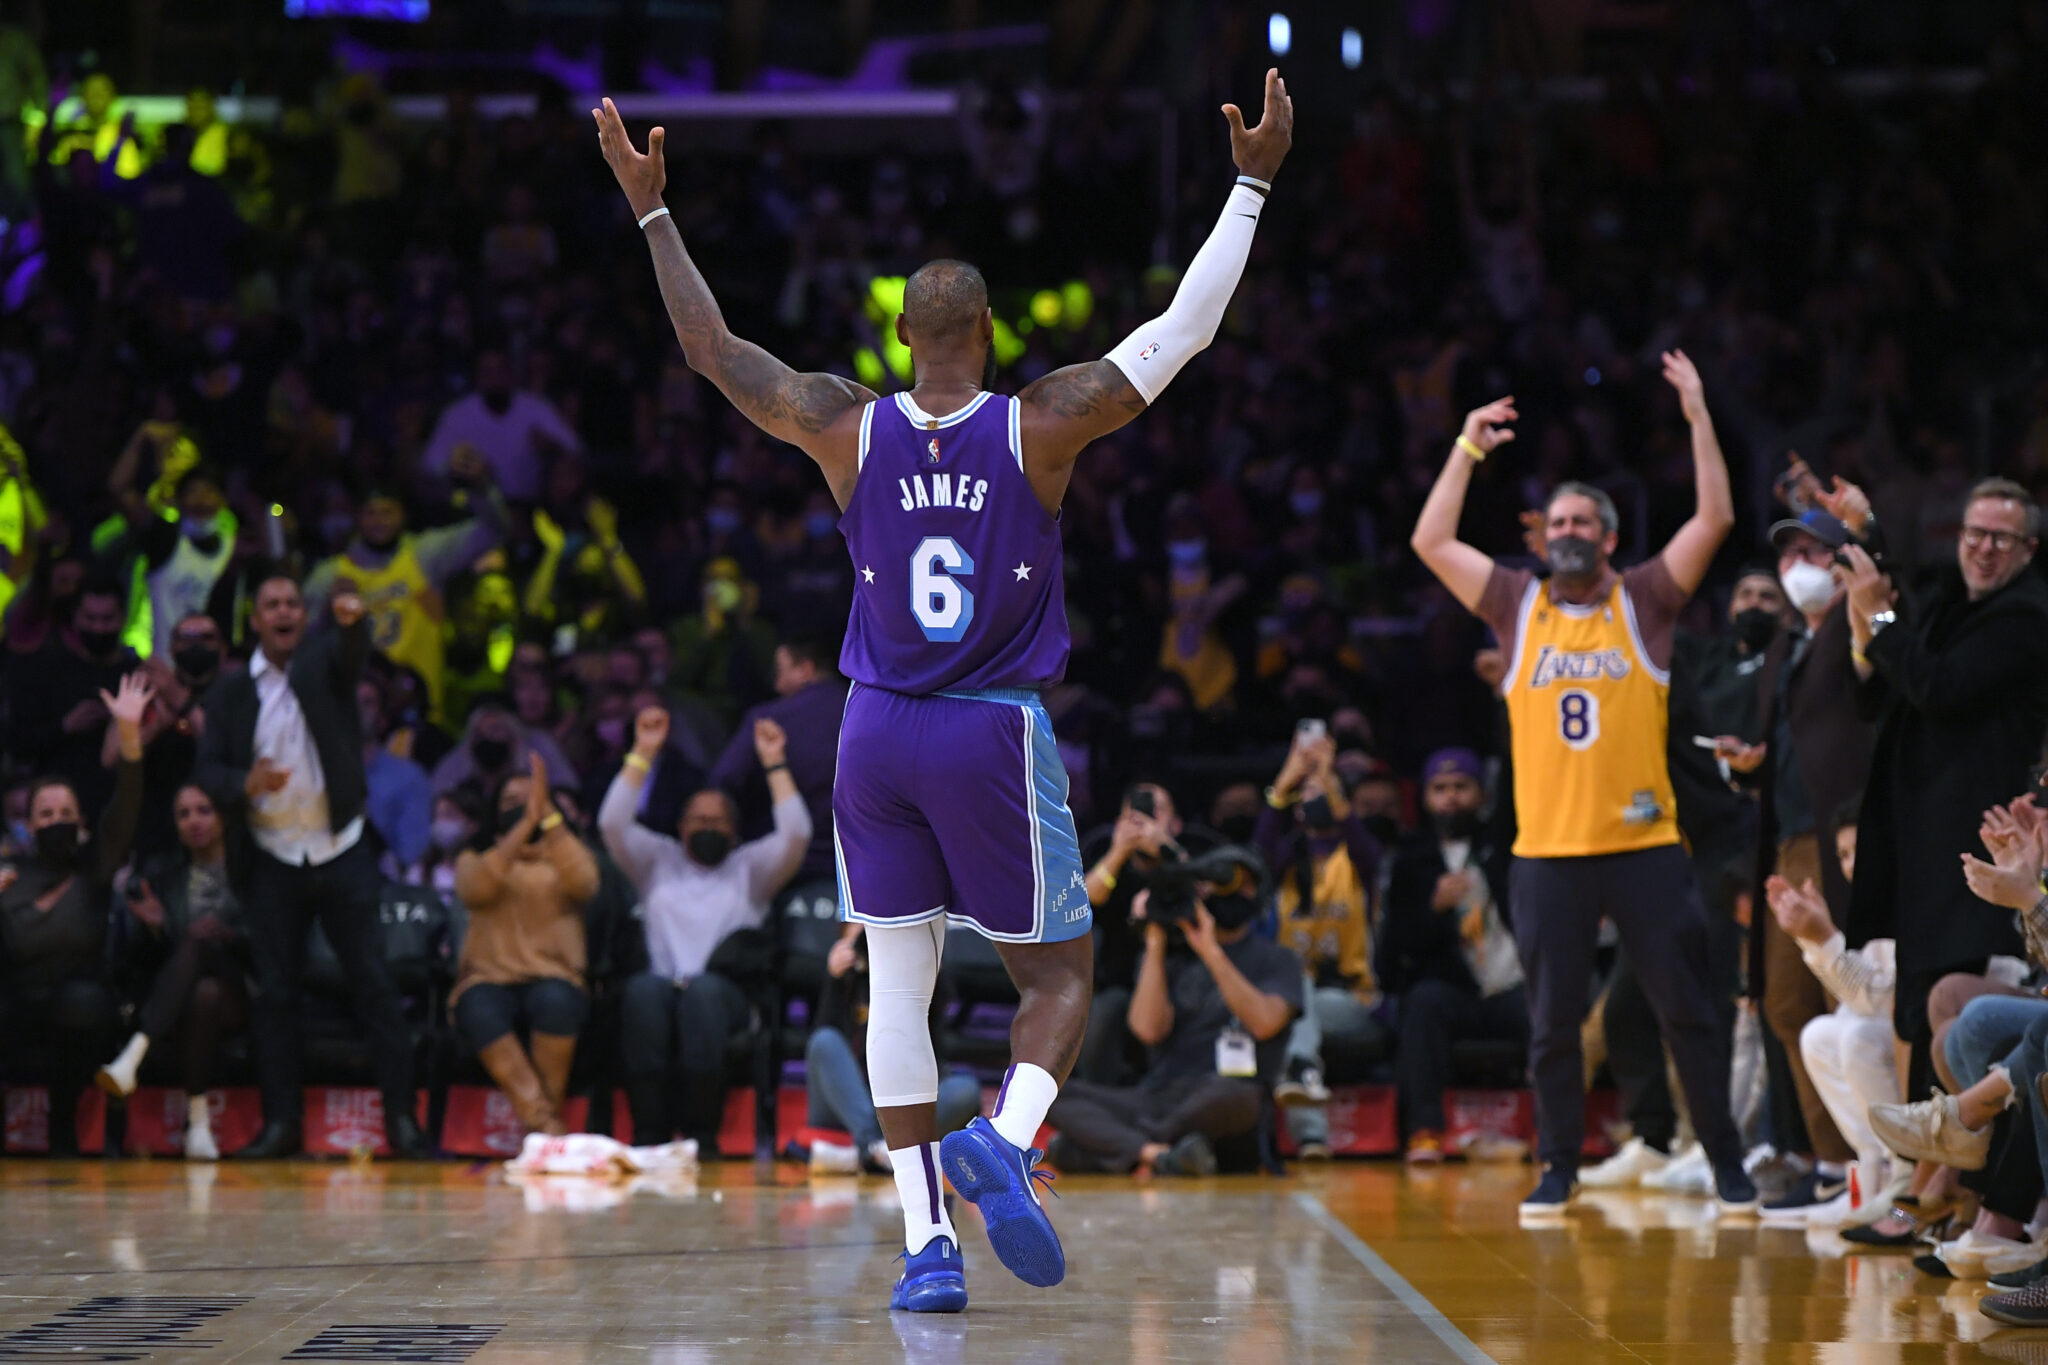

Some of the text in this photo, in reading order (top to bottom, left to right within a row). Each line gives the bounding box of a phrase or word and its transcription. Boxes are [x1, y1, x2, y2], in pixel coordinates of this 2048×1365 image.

[898, 473, 988, 512] JAMES
[910, 536, 974, 642] 6
[1530, 646, 1631, 687] LAKERS
[1560, 689, 1599, 750] 8
[381, 901, 429, 923] LTA
[1052, 888, 1068, 912] LOS
[1064, 903, 1090, 924] LAKERS
[281, 1324, 508, 1363] ARENA
